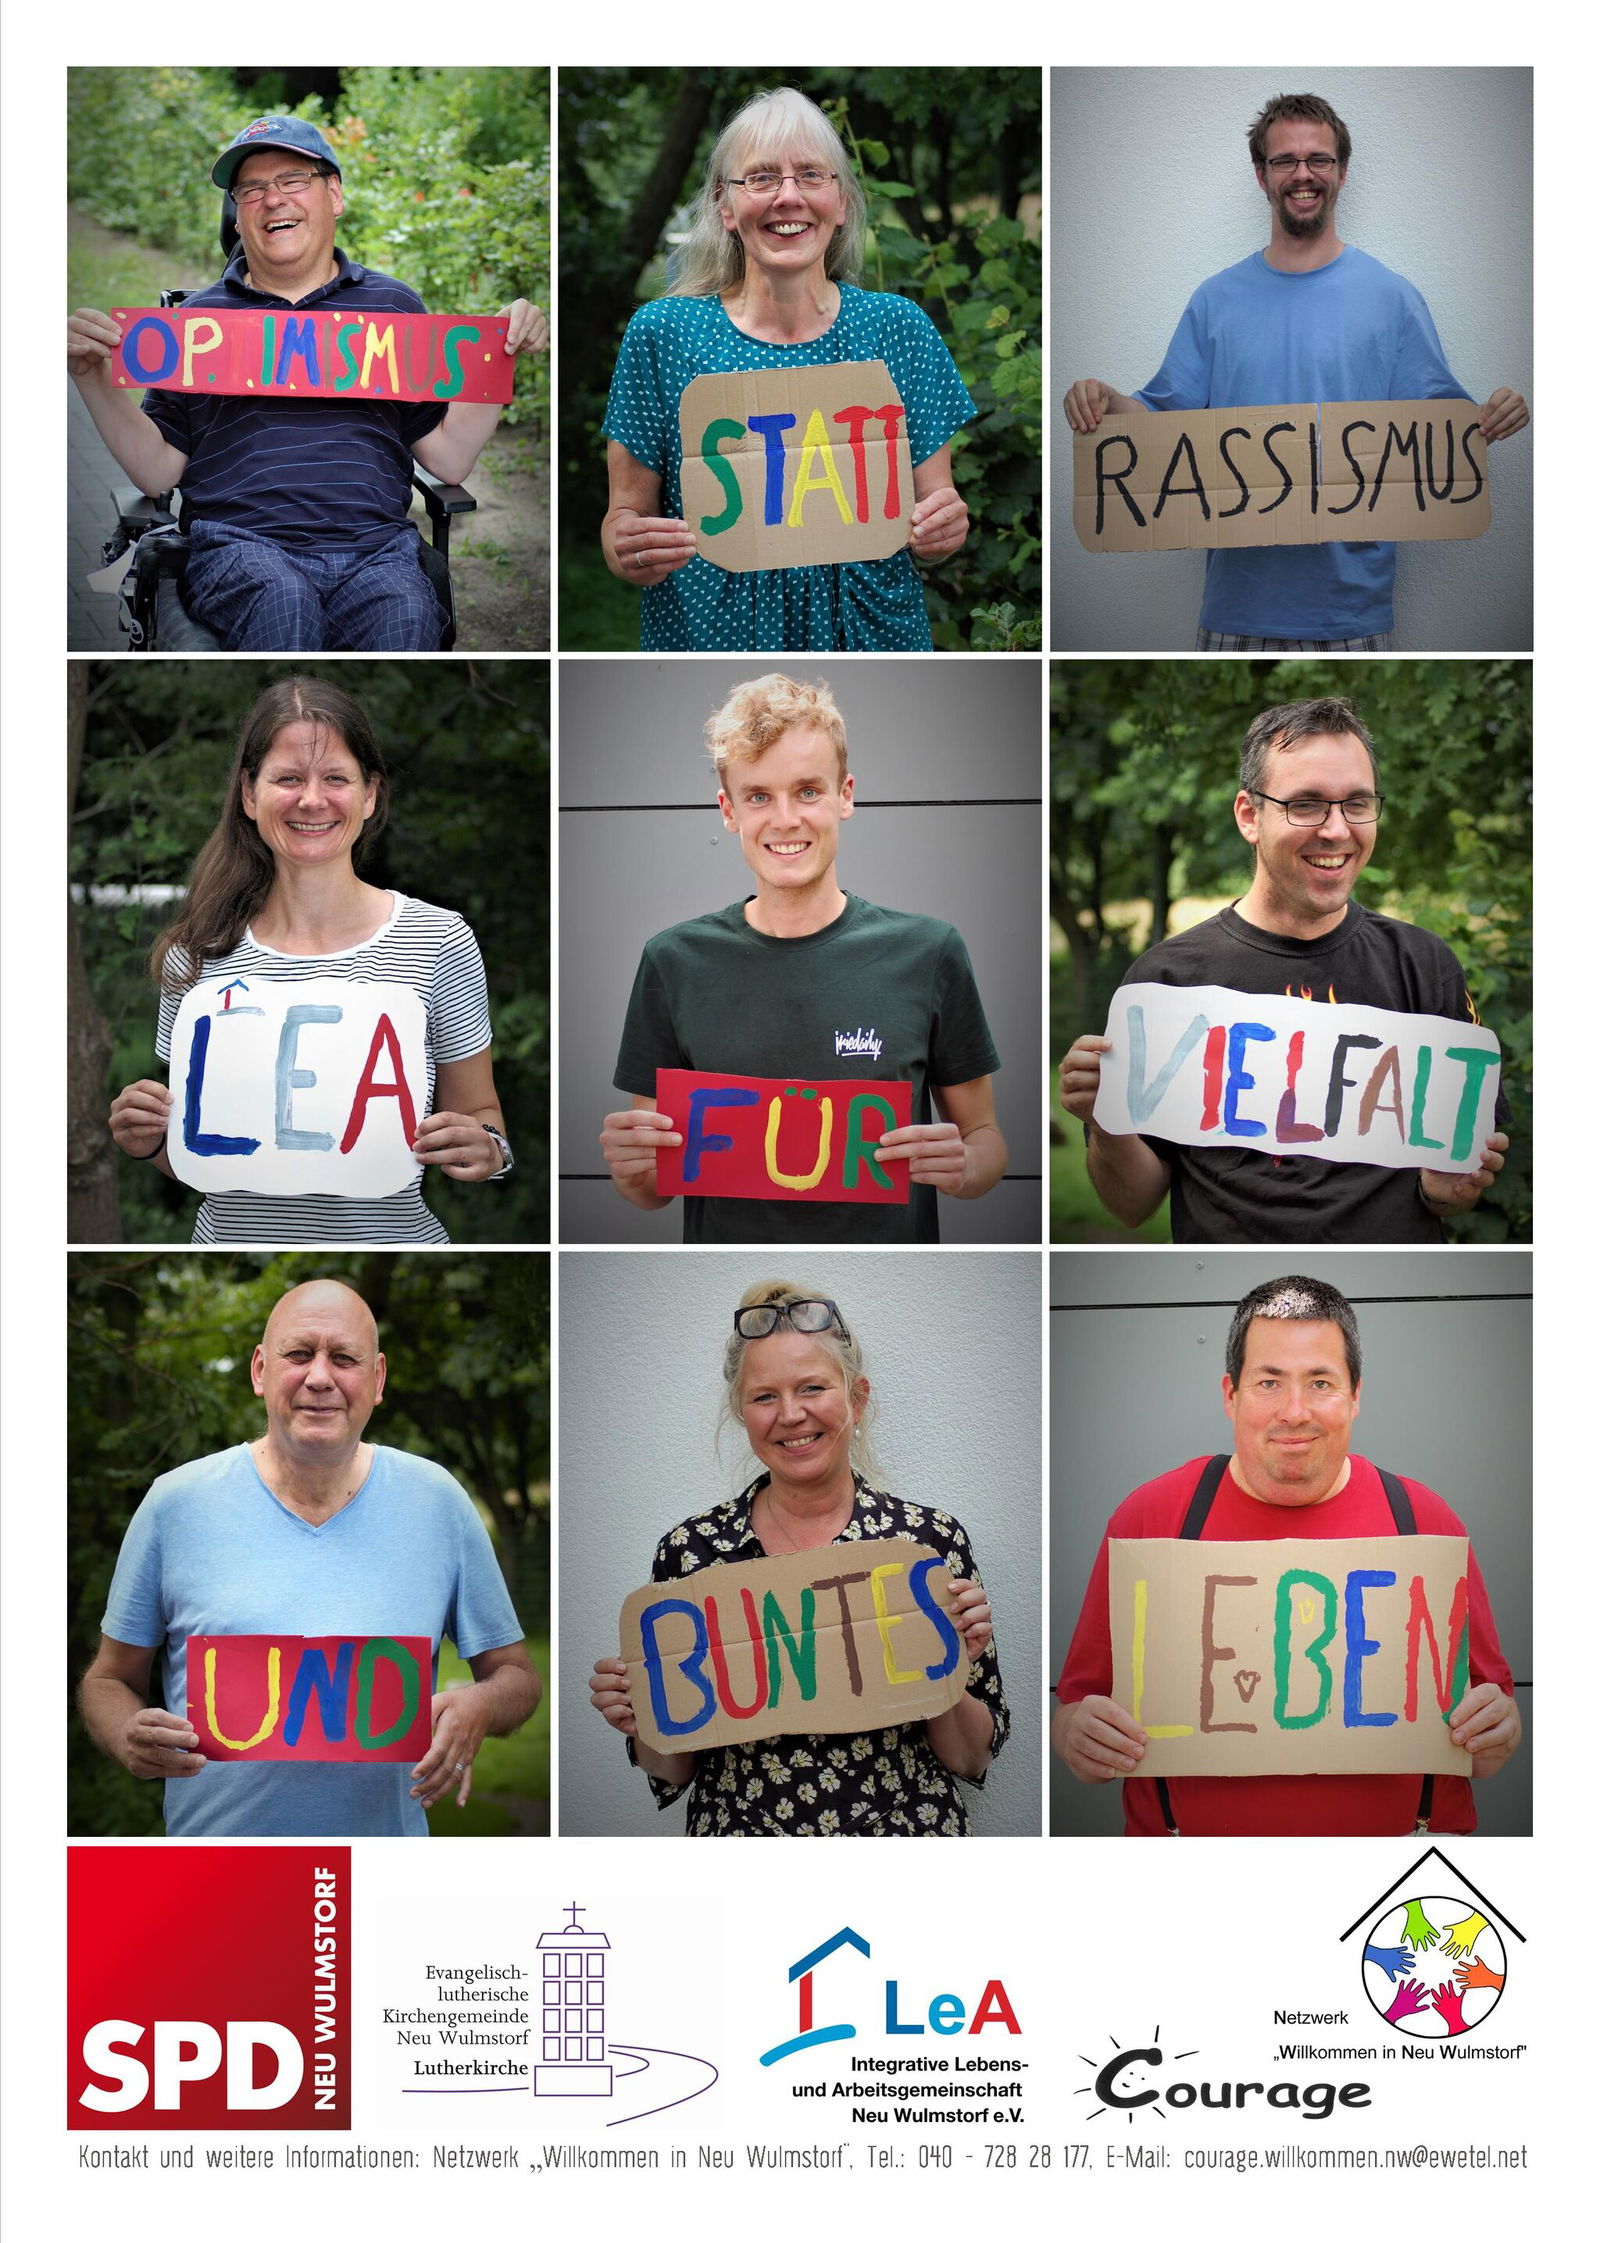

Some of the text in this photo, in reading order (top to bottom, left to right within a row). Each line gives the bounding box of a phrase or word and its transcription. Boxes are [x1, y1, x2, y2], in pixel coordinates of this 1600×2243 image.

[700, 404, 905, 536] STATT
[1095, 420, 1484, 534] RASSISMUS
[183, 1003, 417, 1156] LEA
[1126, 1004, 1501, 1161] VIELFALT
[683, 1087, 897, 1191] FÜR
[640, 1557, 960, 1736] BUNTES
[1132, 1568, 1469, 1739] LEBEN
[204, 1637, 420, 1751] UND
[314, 1867, 337, 2110] NEU WULMSTORF
[425, 1964, 529, 1985] Evangelisch-
[438, 1985, 529, 2002] lutherische
[383, 2007, 529, 2029] Kirchengemeinde
[886, 1979, 1023, 2036] LeA
[1274, 2010, 1349, 2025] Netzwerk
[78, 2019, 305, 2113] SPD
[397, 2029, 532, 2046] Neu Wulmstorf
[851, 2056, 1029, 2076] Integrative Lebens-
[1273, 2044, 1527, 2062] „Willkommen in Neu Wulmstorf"
[414, 2059, 529, 2076] Lutherkirche
[792, 2081, 1023, 2101] und Arbeitsgemeinschaft
[1095, 2047, 1373, 2120] Courage
[852, 2107, 1025, 2124] Neu Wulmstorf e.V.
[79, 2144, 149, 2169] Kontakt
[160, 2144, 194, 2169] und
[206, 2144, 274, 2169] weitere
[286, 2144, 419, 2169] Informationen:
[433, 2144, 519, 2169] Netzwerk
[671, 2145, 686, 2169] in
[698, 2145, 734, 2169] Neu
[866, 2145, 905, 2169] Tel.:
[919, 2144, 952, 2169] 040
[984, 2144, 1017, 2169] 728
[1029, 2144, 1051, 2169] 28
[1063, 2144, 1093, 2170] 177,
[1107, 2145, 1171, 2169] E-Mail:
[1184, 2144, 1528, 2173] courage.willkommen.nw@ewetel.net
